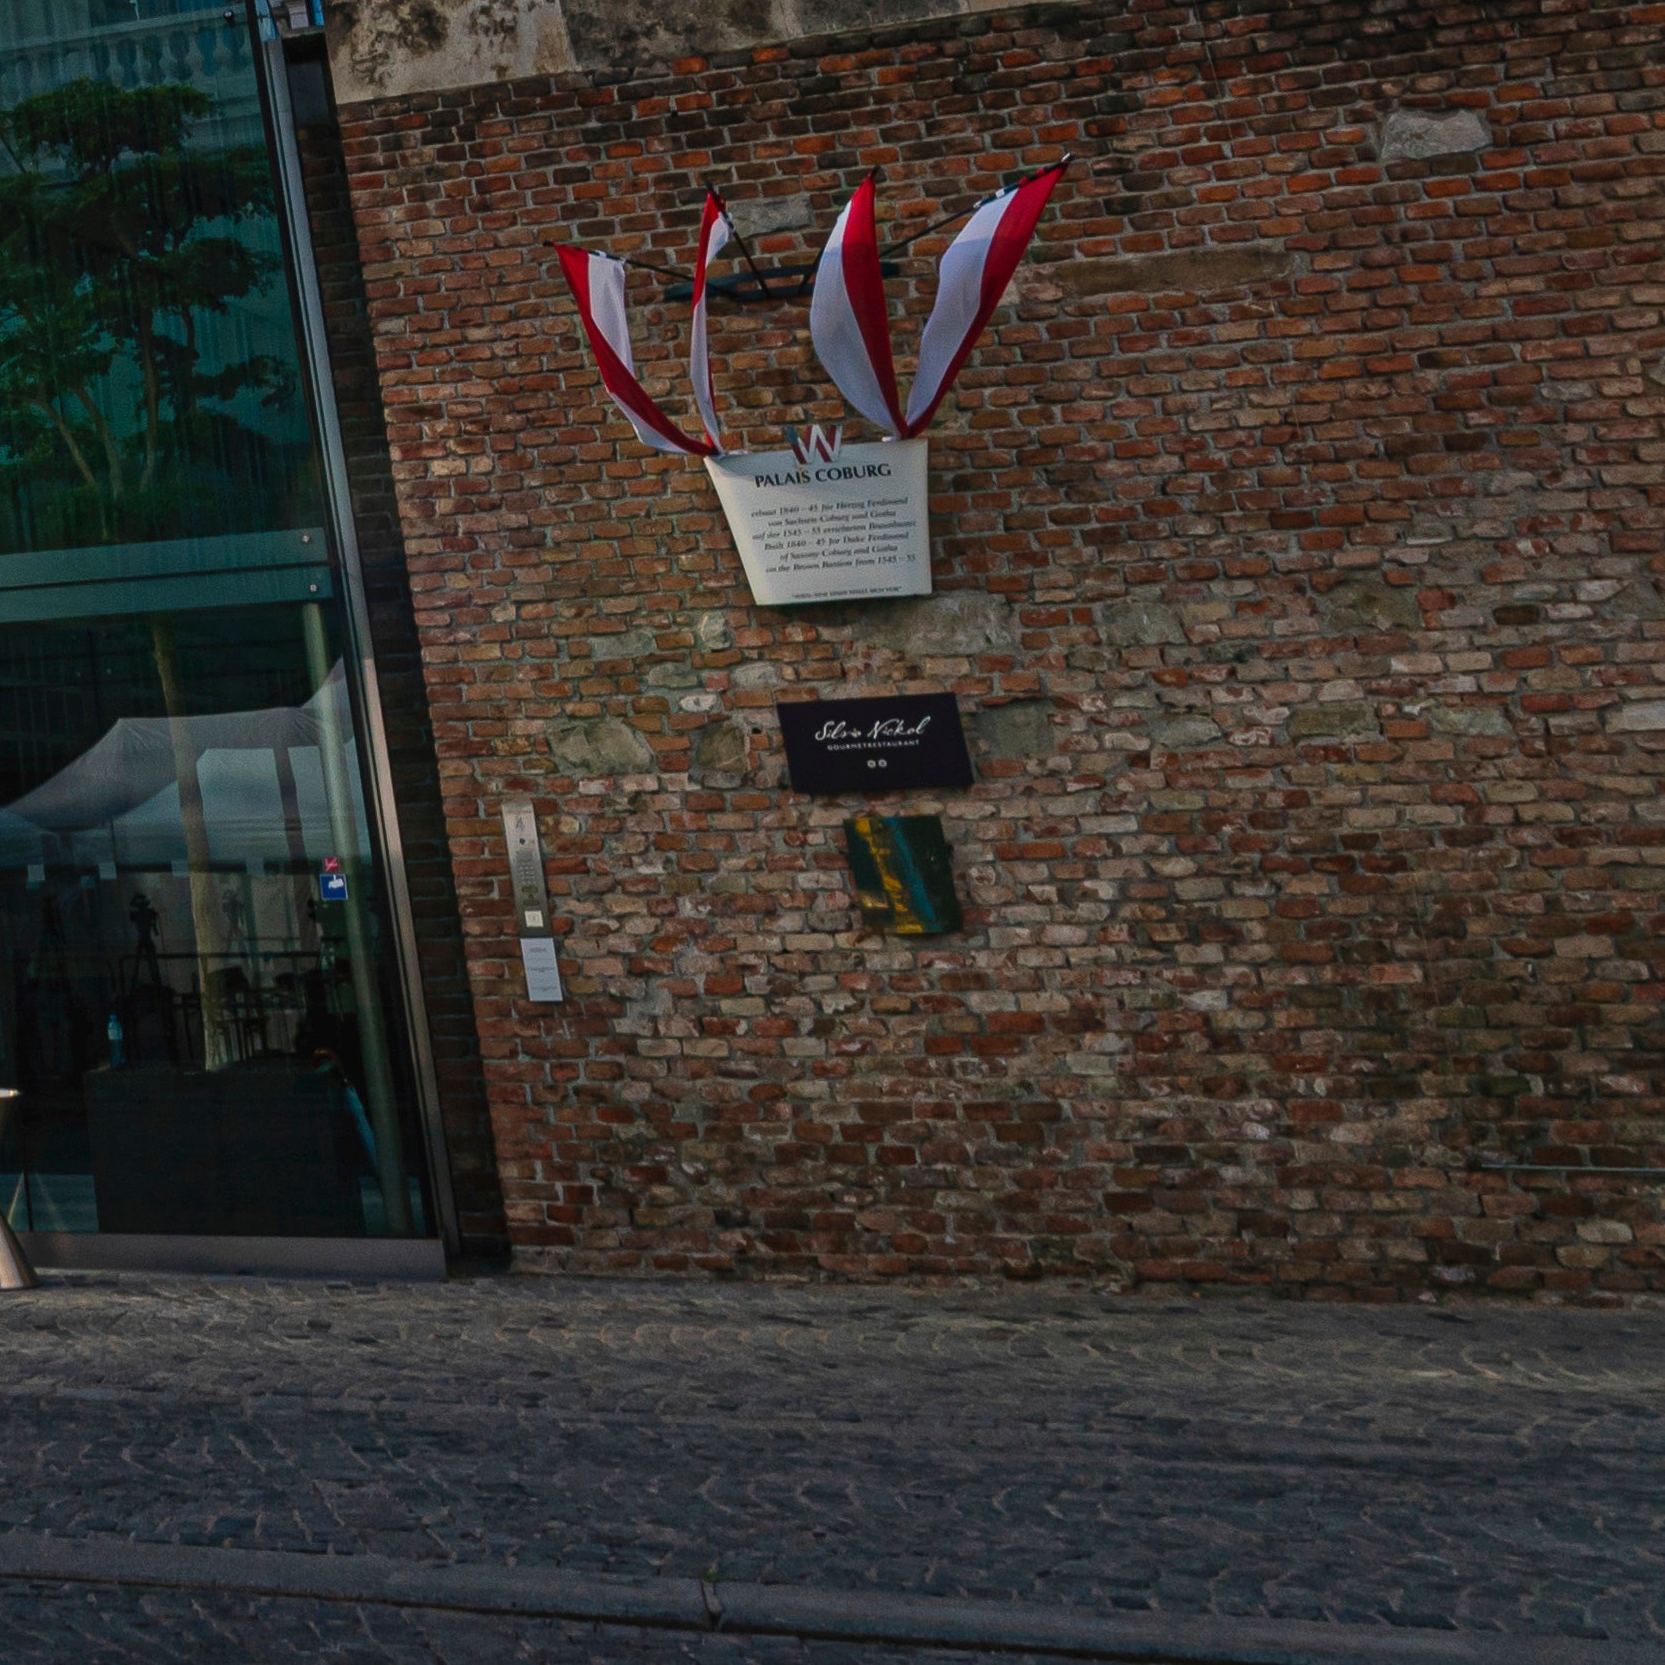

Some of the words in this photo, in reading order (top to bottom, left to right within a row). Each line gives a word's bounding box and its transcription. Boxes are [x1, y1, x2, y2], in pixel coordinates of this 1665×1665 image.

[755, 470, 811, 488] PALAIS
[815, 463, 892, 483] COBURG
[867, 715, 932, 740] Nickol
[827, 739, 920, 751] GOURMETRESTAURANT
